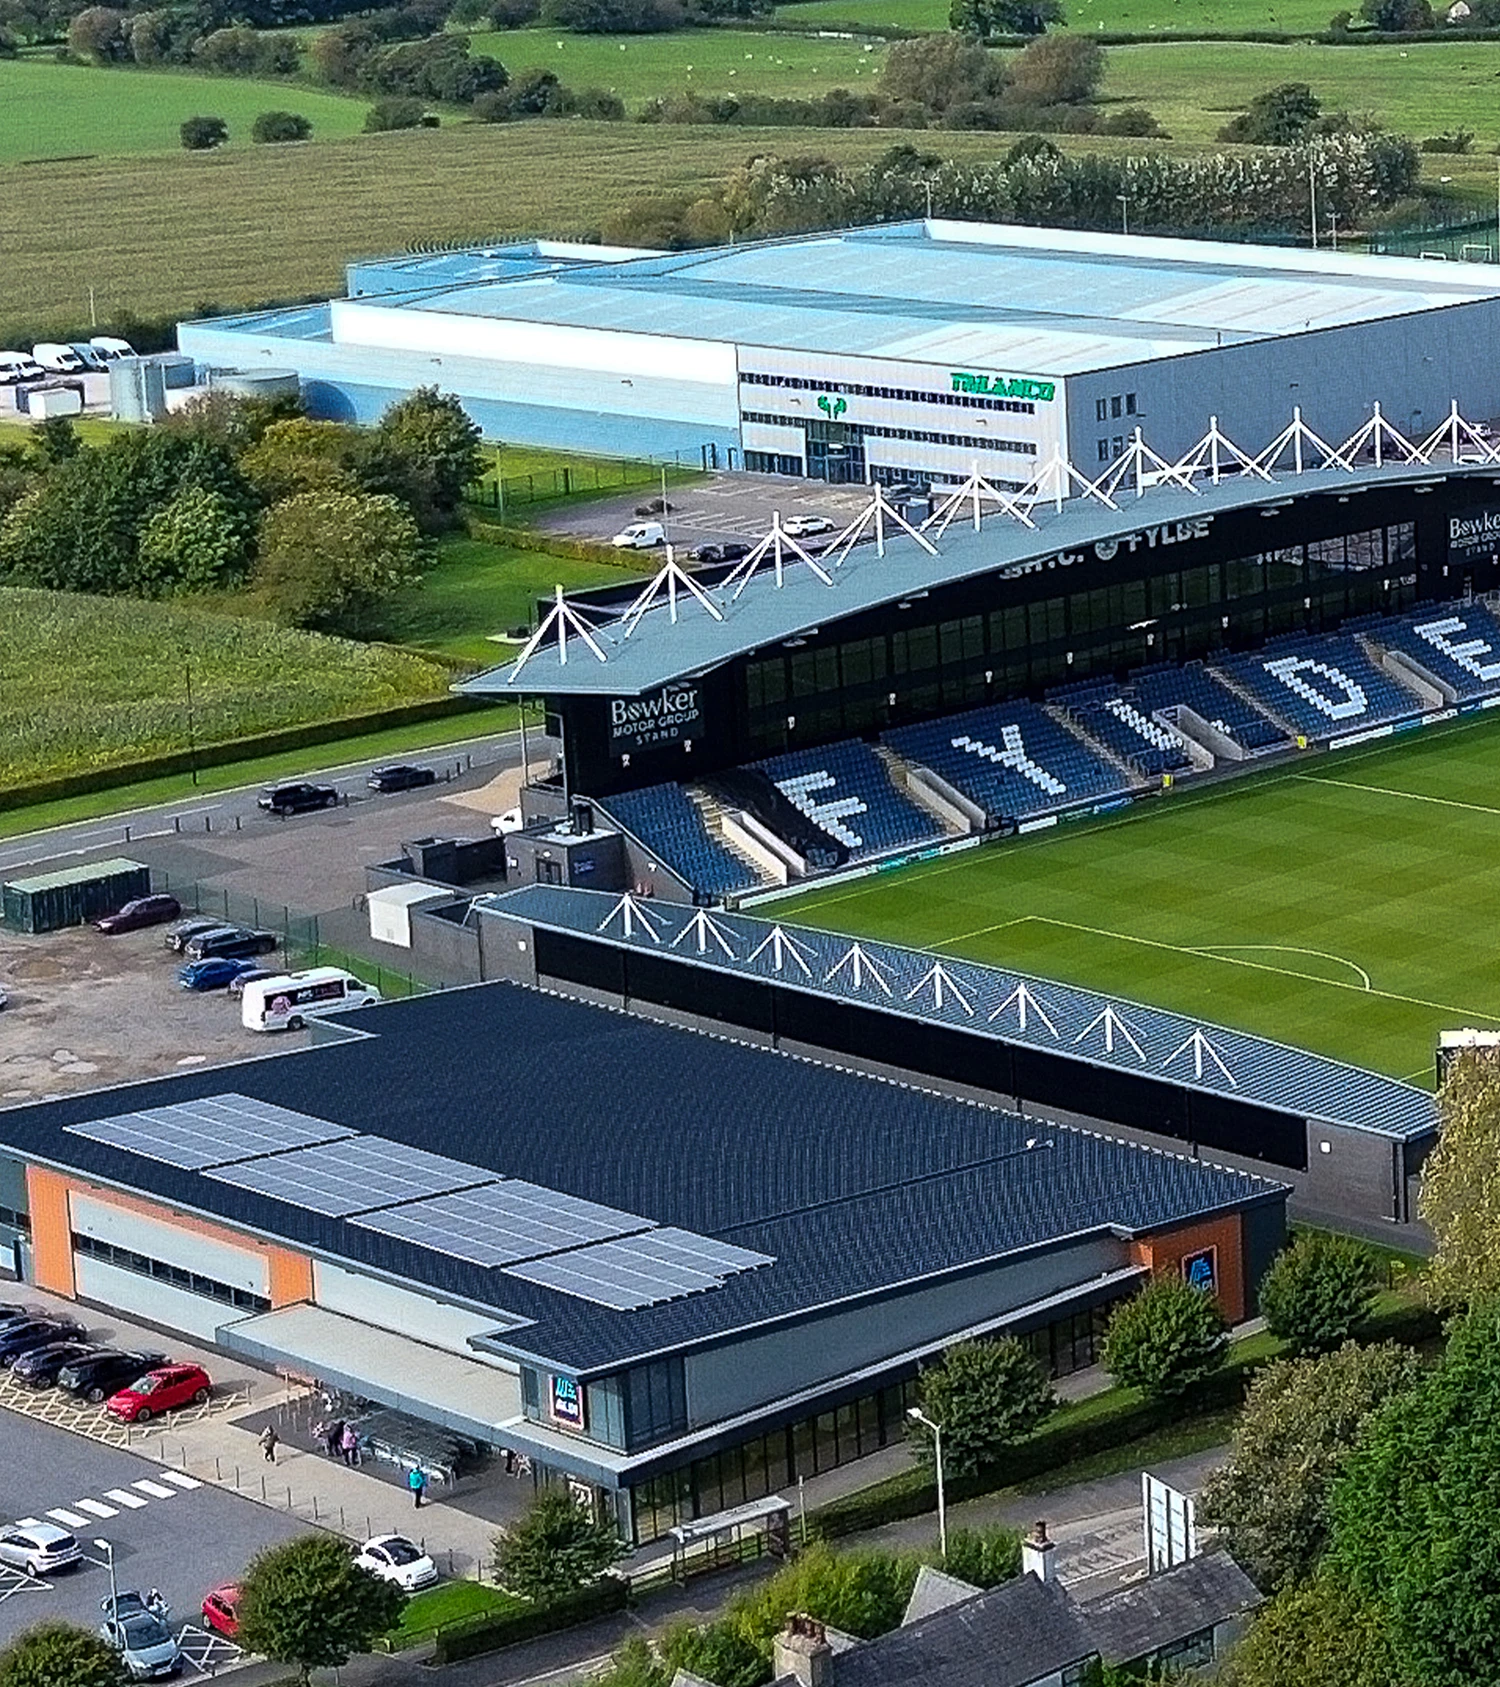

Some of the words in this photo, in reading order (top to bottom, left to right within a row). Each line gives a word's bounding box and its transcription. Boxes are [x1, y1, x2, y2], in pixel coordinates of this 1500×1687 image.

[612, 688, 698, 726] Bowker
[612, 719, 655, 738] MOTOR
[658, 708, 699, 727] GROUP
[636, 727, 679, 746] STAND
